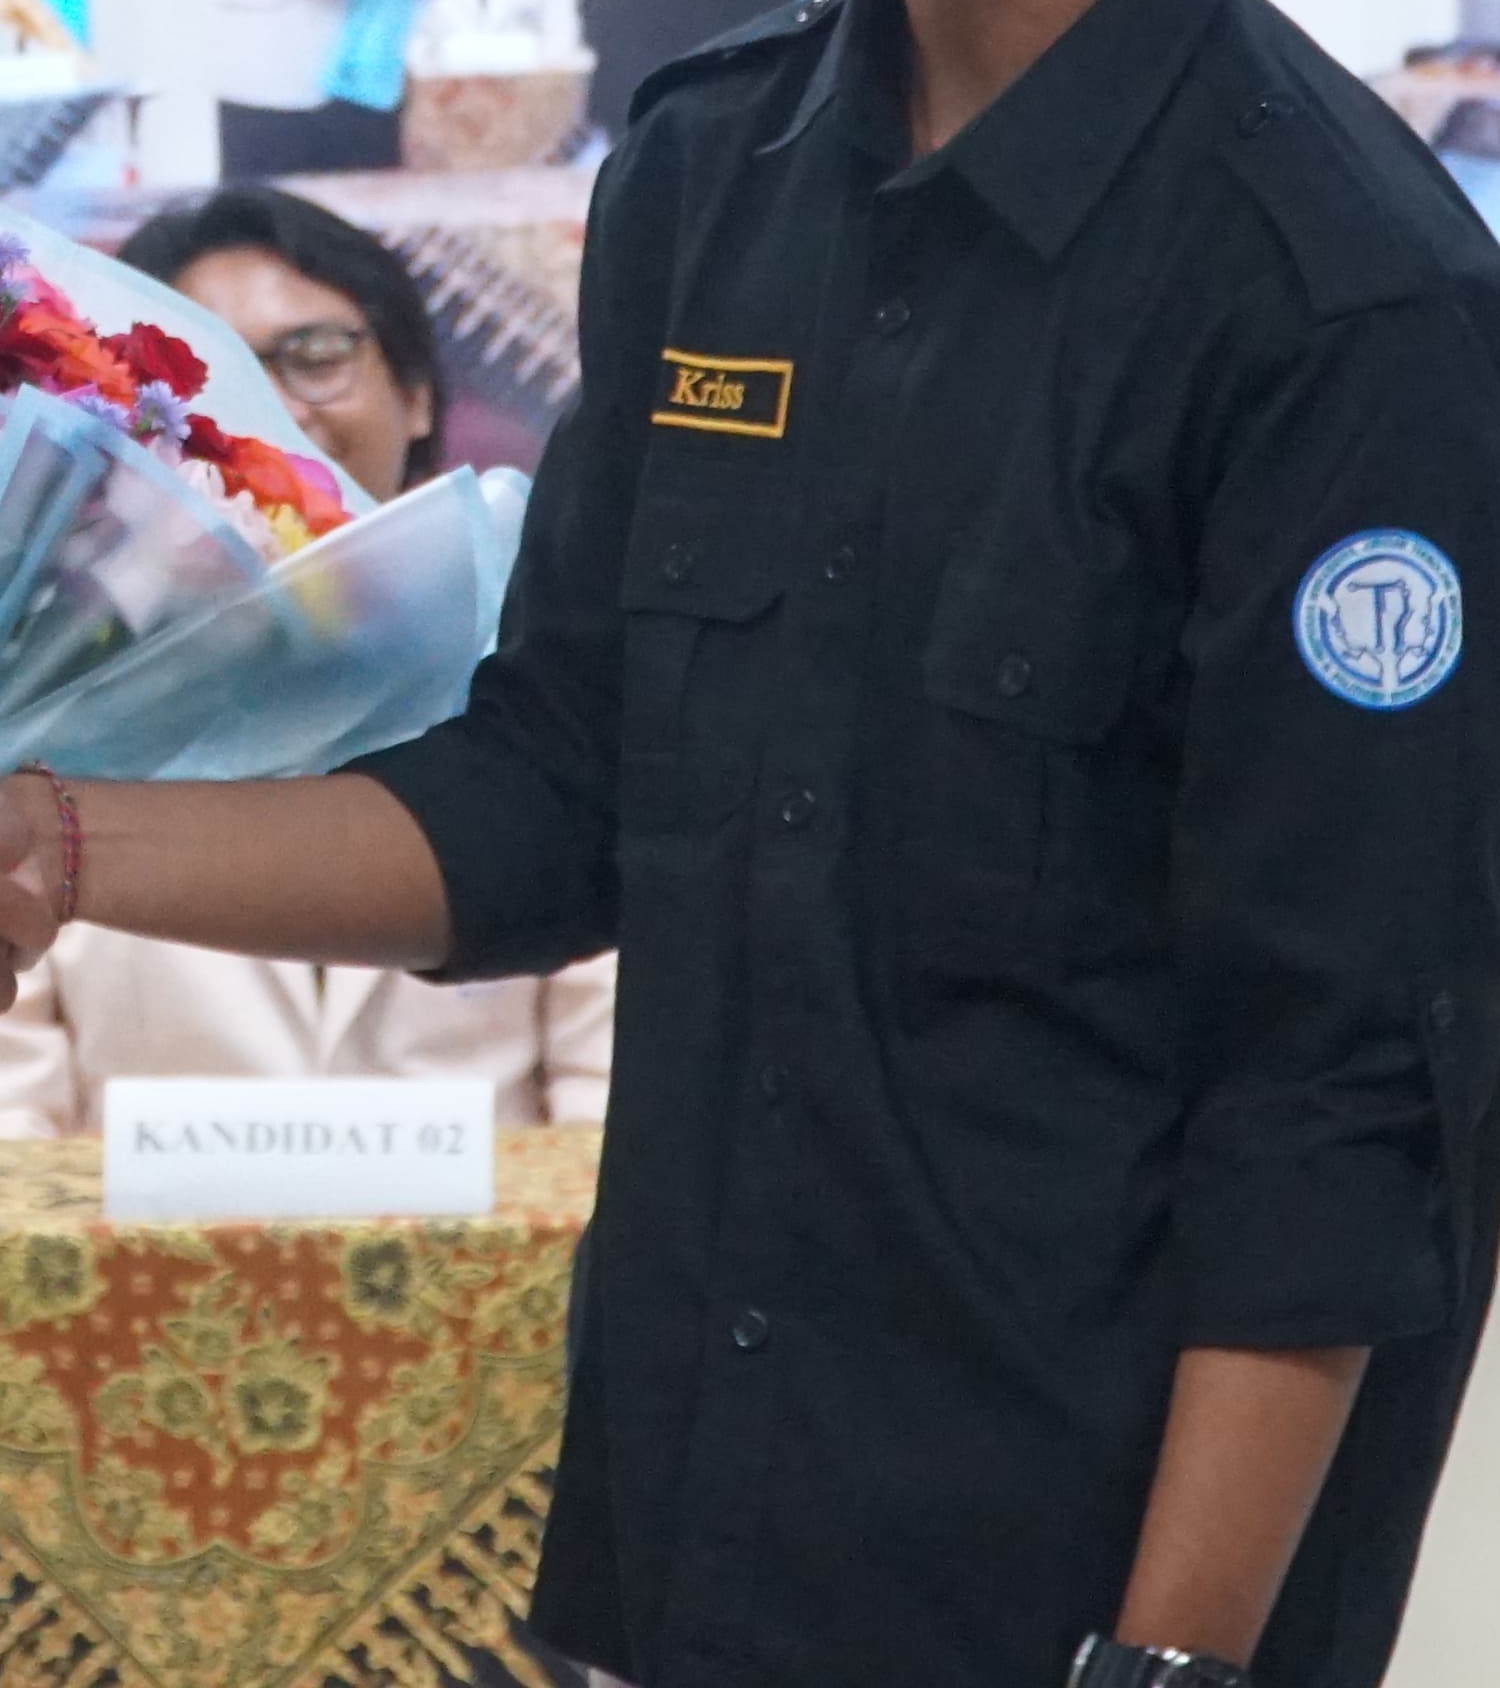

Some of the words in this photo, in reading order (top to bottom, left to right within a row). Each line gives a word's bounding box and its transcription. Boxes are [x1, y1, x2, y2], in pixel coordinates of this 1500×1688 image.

[669, 366, 745, 410] Kriss
[133, 1120, 399, 1156] KANDIDAT
[416, 1123, 465, 1156] 02
